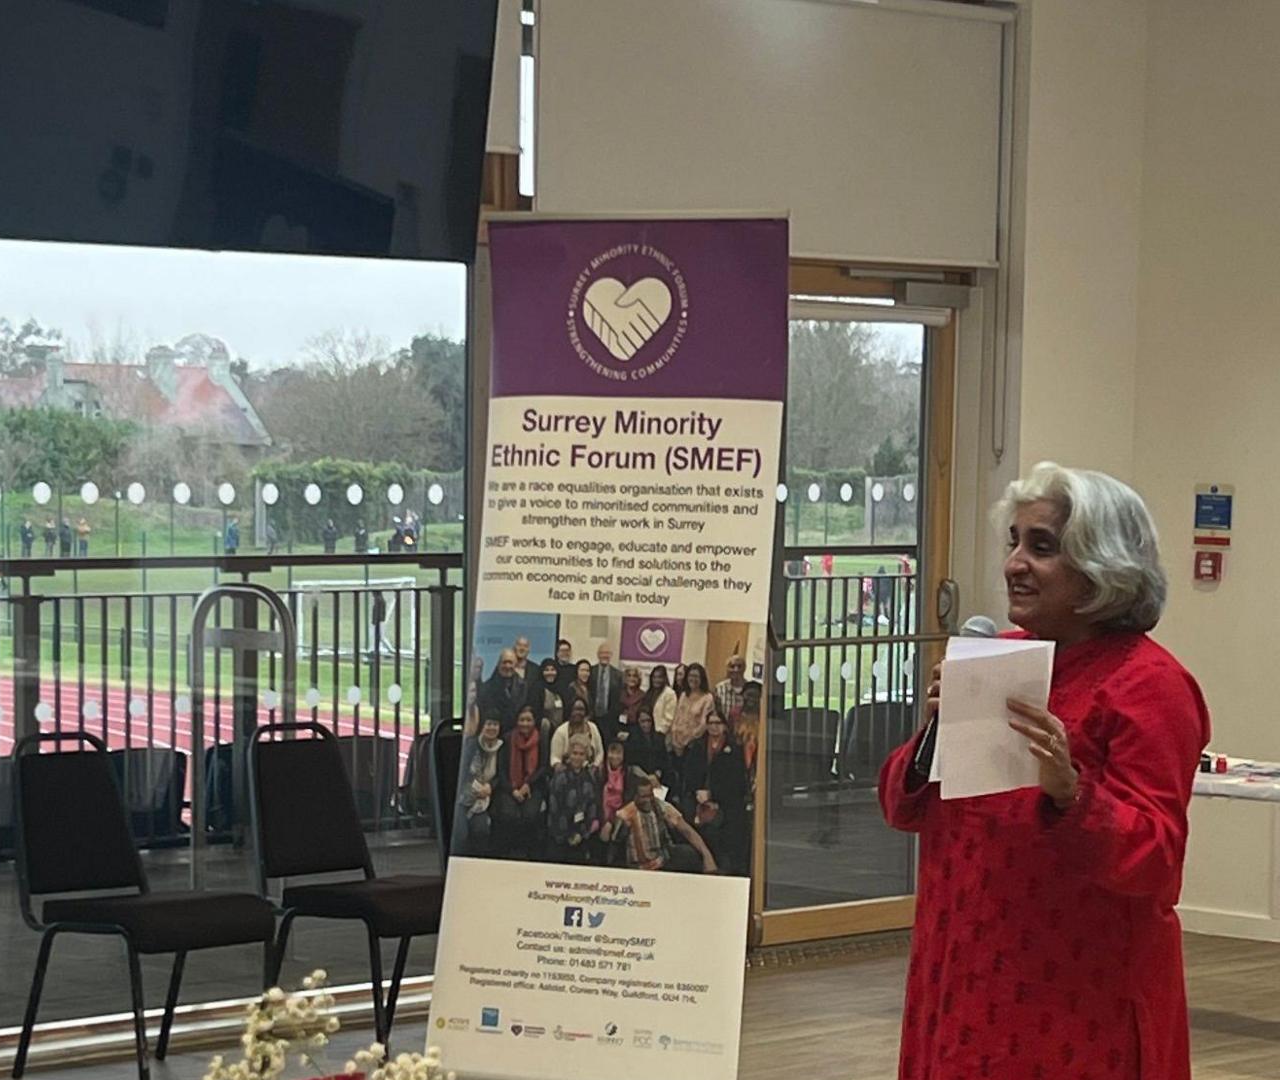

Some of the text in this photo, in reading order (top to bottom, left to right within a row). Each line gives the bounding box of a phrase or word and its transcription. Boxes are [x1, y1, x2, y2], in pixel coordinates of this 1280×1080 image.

[569, 244, 688, 309] SURREY MINORITY ETHNIC FORUM
[567, 319, 688, 381] STRENGTHENING COMMUNITIES
[522, 409, 722, 441] Surrey Minority
[491, 444, 762, 478] Ethnic Forum (SMEF)
[501, 482, 516, 491] are
[519, 482, 526, 491] a
[528, 482, 554, 492] race
[557, 482, 616, 496] equalities
[620, 483, 693, 497] organisation
[696, 484, 721, 496] that
[724, 485, 764, 498] exists
[497, 499, 517, 511] give
[520, 499, 526, 508] a
[530, 499, 561, 509] voice
[565, 499, 578, 509] to
[582, 499, 649, 512] minoritised
[652, 501, 728, 514] communities
[733, 504, 759, 515] and
[521, 514, 705, 533] strengthen their work in Surrey
[512, 537, 546, 548] works
[550, 538, 563, 549] to
[566, 540, 615, 554] engage,
[618, 540, 668, 553] educate
[671, 542, 693, 554] and
[695, 543, 757, 556] empower
[496, 555, 731, 572] our communities to find solutions to the
[527, 572, 587, 584] economic
[590, 574, 613, 585] and
[616, 575, 653, 587] social
[656, 576, 719, 591] challenges
[723, 577, 752, 593] they
[548, 588, 670, 607] face in Britain today
[545, 880, 635, 895] www.smef.org.uk
[516, 940, 551, 952] Contact
[517, 928, 656, 947] Facebook/Twitter @SurreySMEF
[537, 955, 566, 966] Phone:
[459, 964, 501, 975] Registered
[503, 968, 529, 979] charity
[579, 974, 616, 987] Company
[469, 976, 511, 988] Registered
